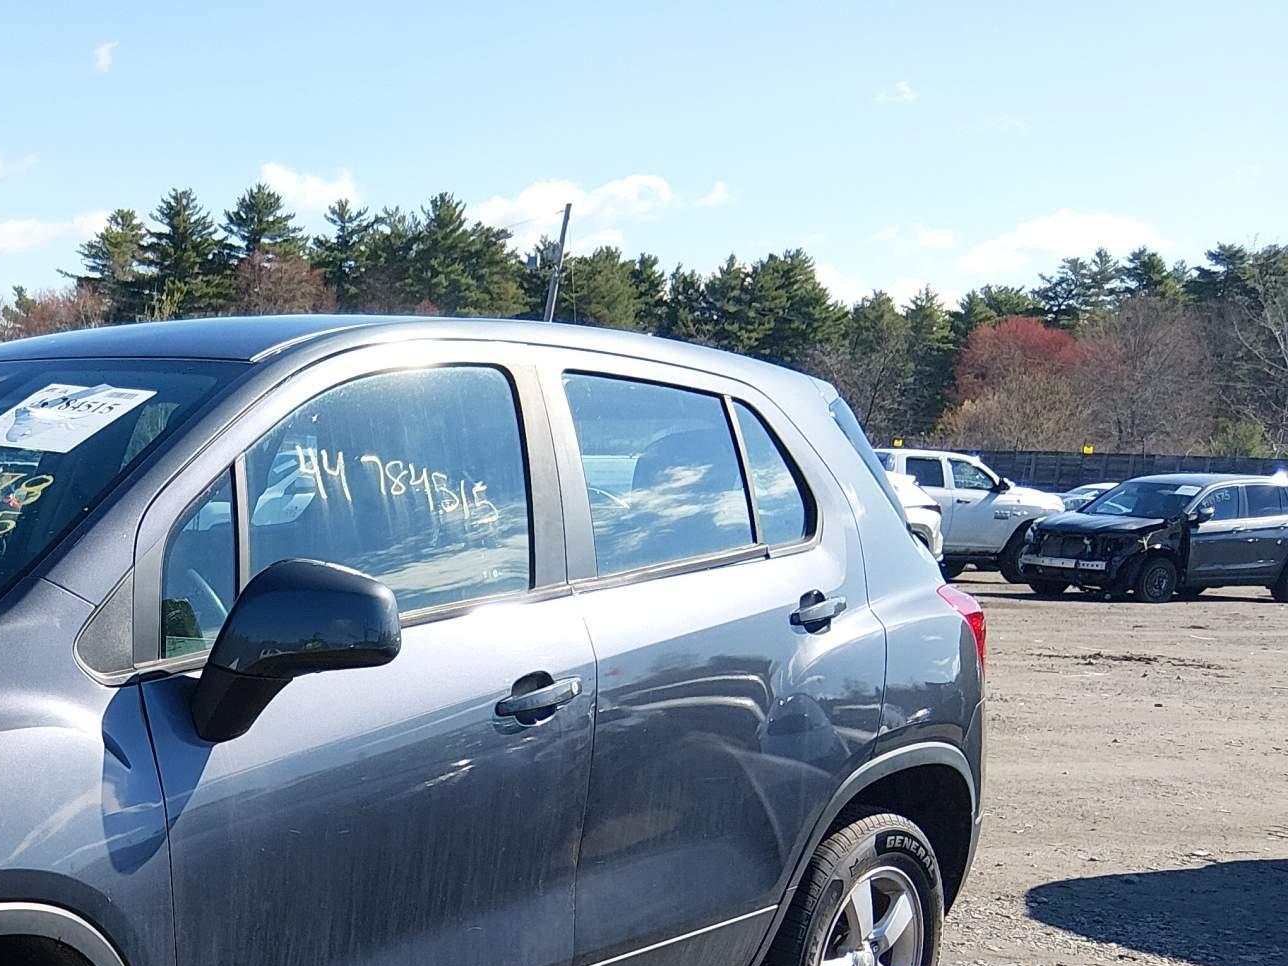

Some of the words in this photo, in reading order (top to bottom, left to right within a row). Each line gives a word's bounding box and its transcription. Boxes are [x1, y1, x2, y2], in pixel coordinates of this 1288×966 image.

[295, 444, 353, 502] 44
[360, 456, 500, 526] 784515
[885, 835, 937, 881] GENERAL
